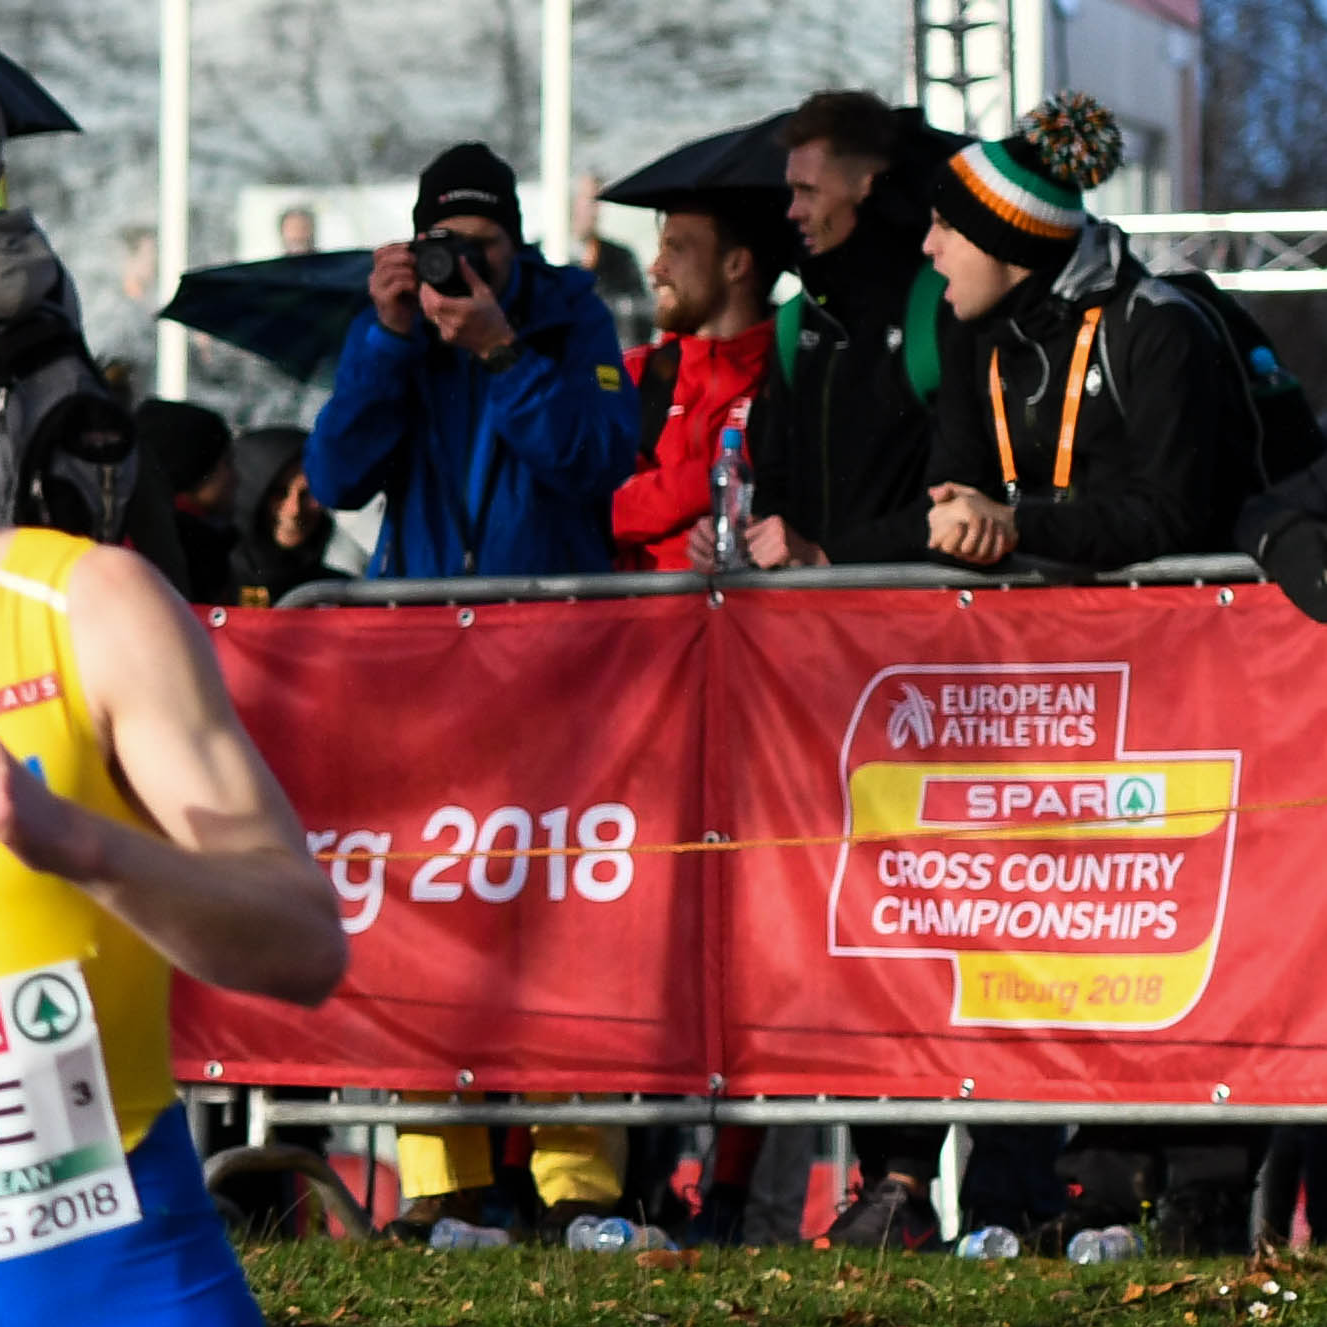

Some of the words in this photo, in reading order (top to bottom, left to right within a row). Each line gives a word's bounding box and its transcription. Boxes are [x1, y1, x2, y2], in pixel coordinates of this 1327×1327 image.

[939, 683, 1096, 717] EUROPEAN
[939, 715, 1097, 748] ATHLETICS
[966, 783, 1107, 819] SPAR
[409, 802, 638, 904] 2018
[877, 849, 995, 890] CROSS
[999, 851, 1185, 893] COUNTRY
[871, 895, 1178, 940] CHAMPIONSHIPS
[979, 970, 1080, 1013] Tilburg
[1088, 974, 1164, 1005] 2018
[28, 1183, 120, 1240] 2018
